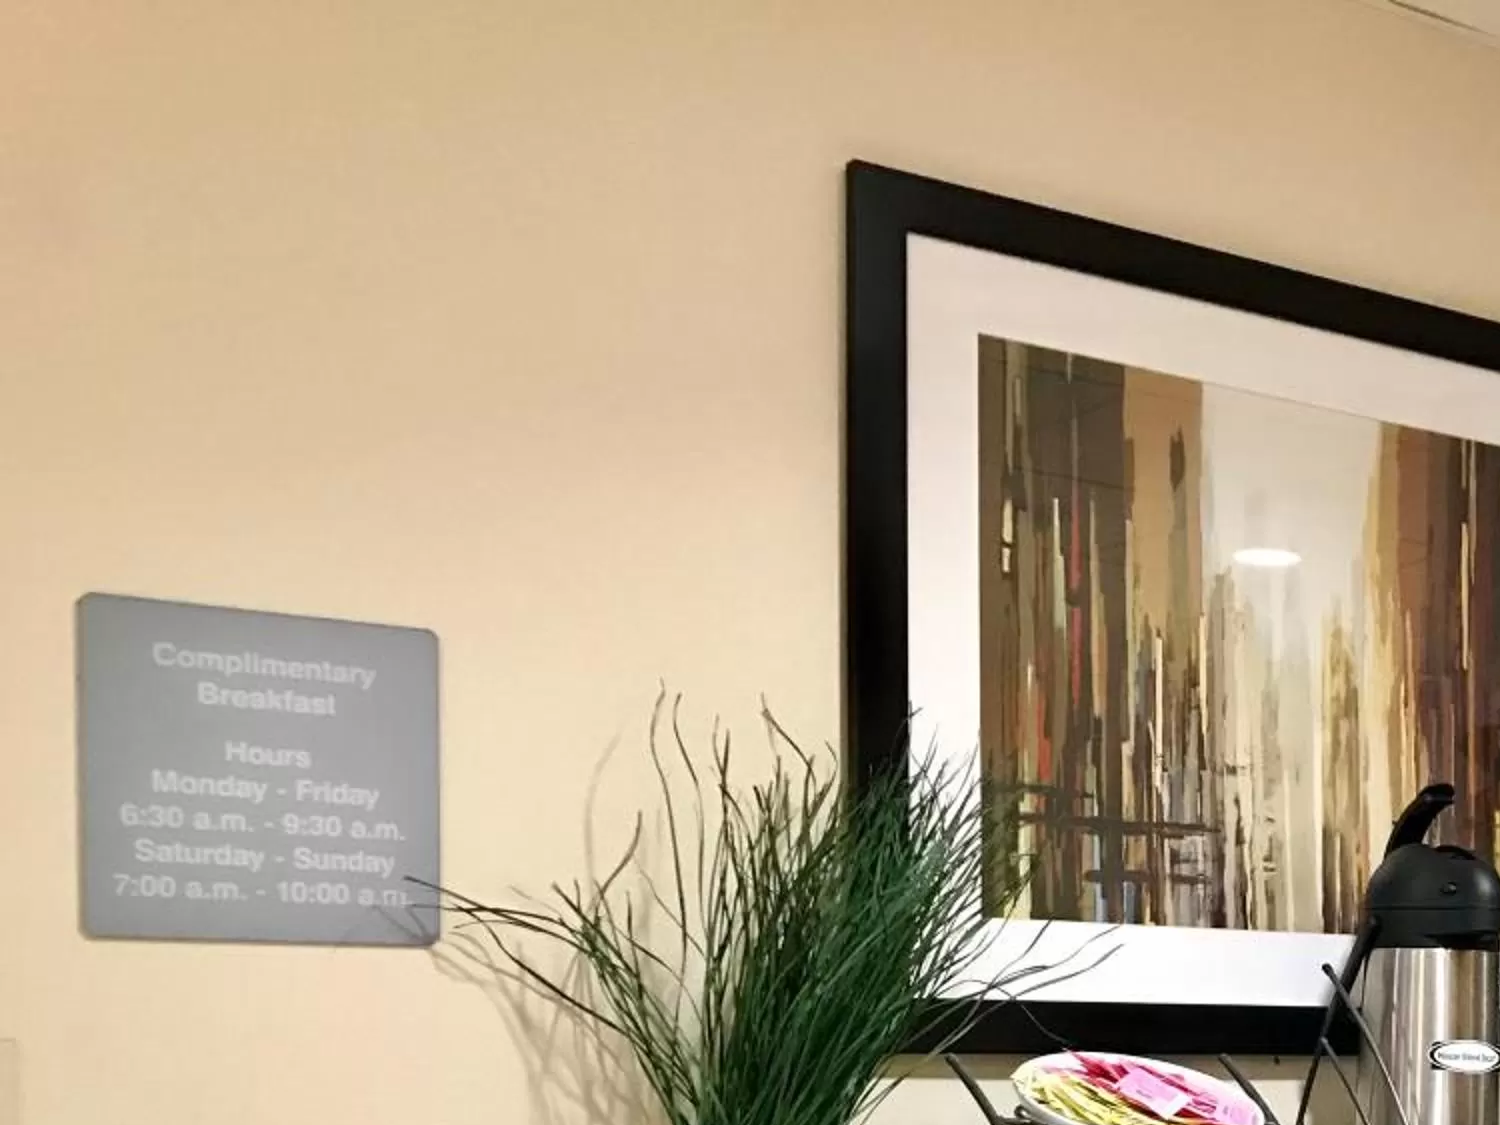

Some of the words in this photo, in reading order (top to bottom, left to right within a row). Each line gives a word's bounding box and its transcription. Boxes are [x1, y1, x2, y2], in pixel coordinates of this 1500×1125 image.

[153, 642, 377, 690] Complimentary
[198, 681, 336, 716] Breakfast
[225, 740, 312, 769] Hours
[151, 768, 267, 804] Monday
[296, 779, 380, 811] Friday
[119, 801, 184, 828] 6:30
[193, 811, 254, 833] a.m.
[282, 812, 343, 837] 9:30
[351, 819, 406, 841] a.m.
[134, 837, 265, 873] Saturday
[293, 847, 395, 879] Sunday
[112, 873, 176, 898] 7:00
[185, 880, 248, 901] a.m.
[277, 880, 349, 905] 10:00
